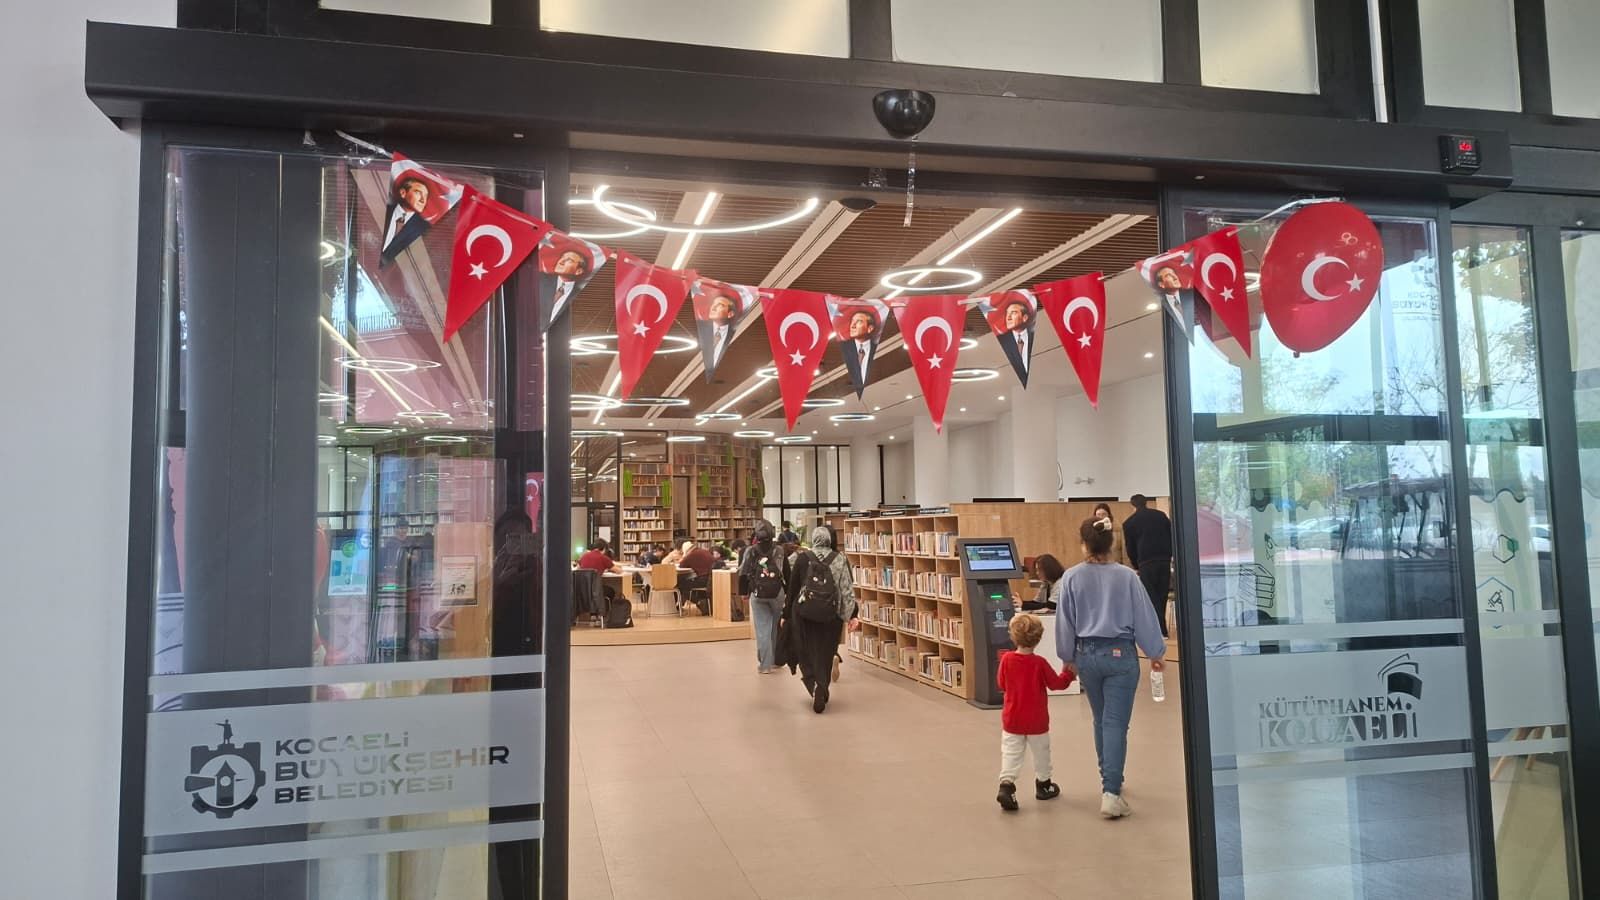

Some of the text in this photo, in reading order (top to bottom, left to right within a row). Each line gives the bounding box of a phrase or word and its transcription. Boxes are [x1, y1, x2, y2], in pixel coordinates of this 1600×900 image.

[275, 731, 409, 757] KOCAELİ
[274, 745, 510, 782] BÜYÜKŞEHİR
[274, 774, 454, 804] BELEDİYESİ
